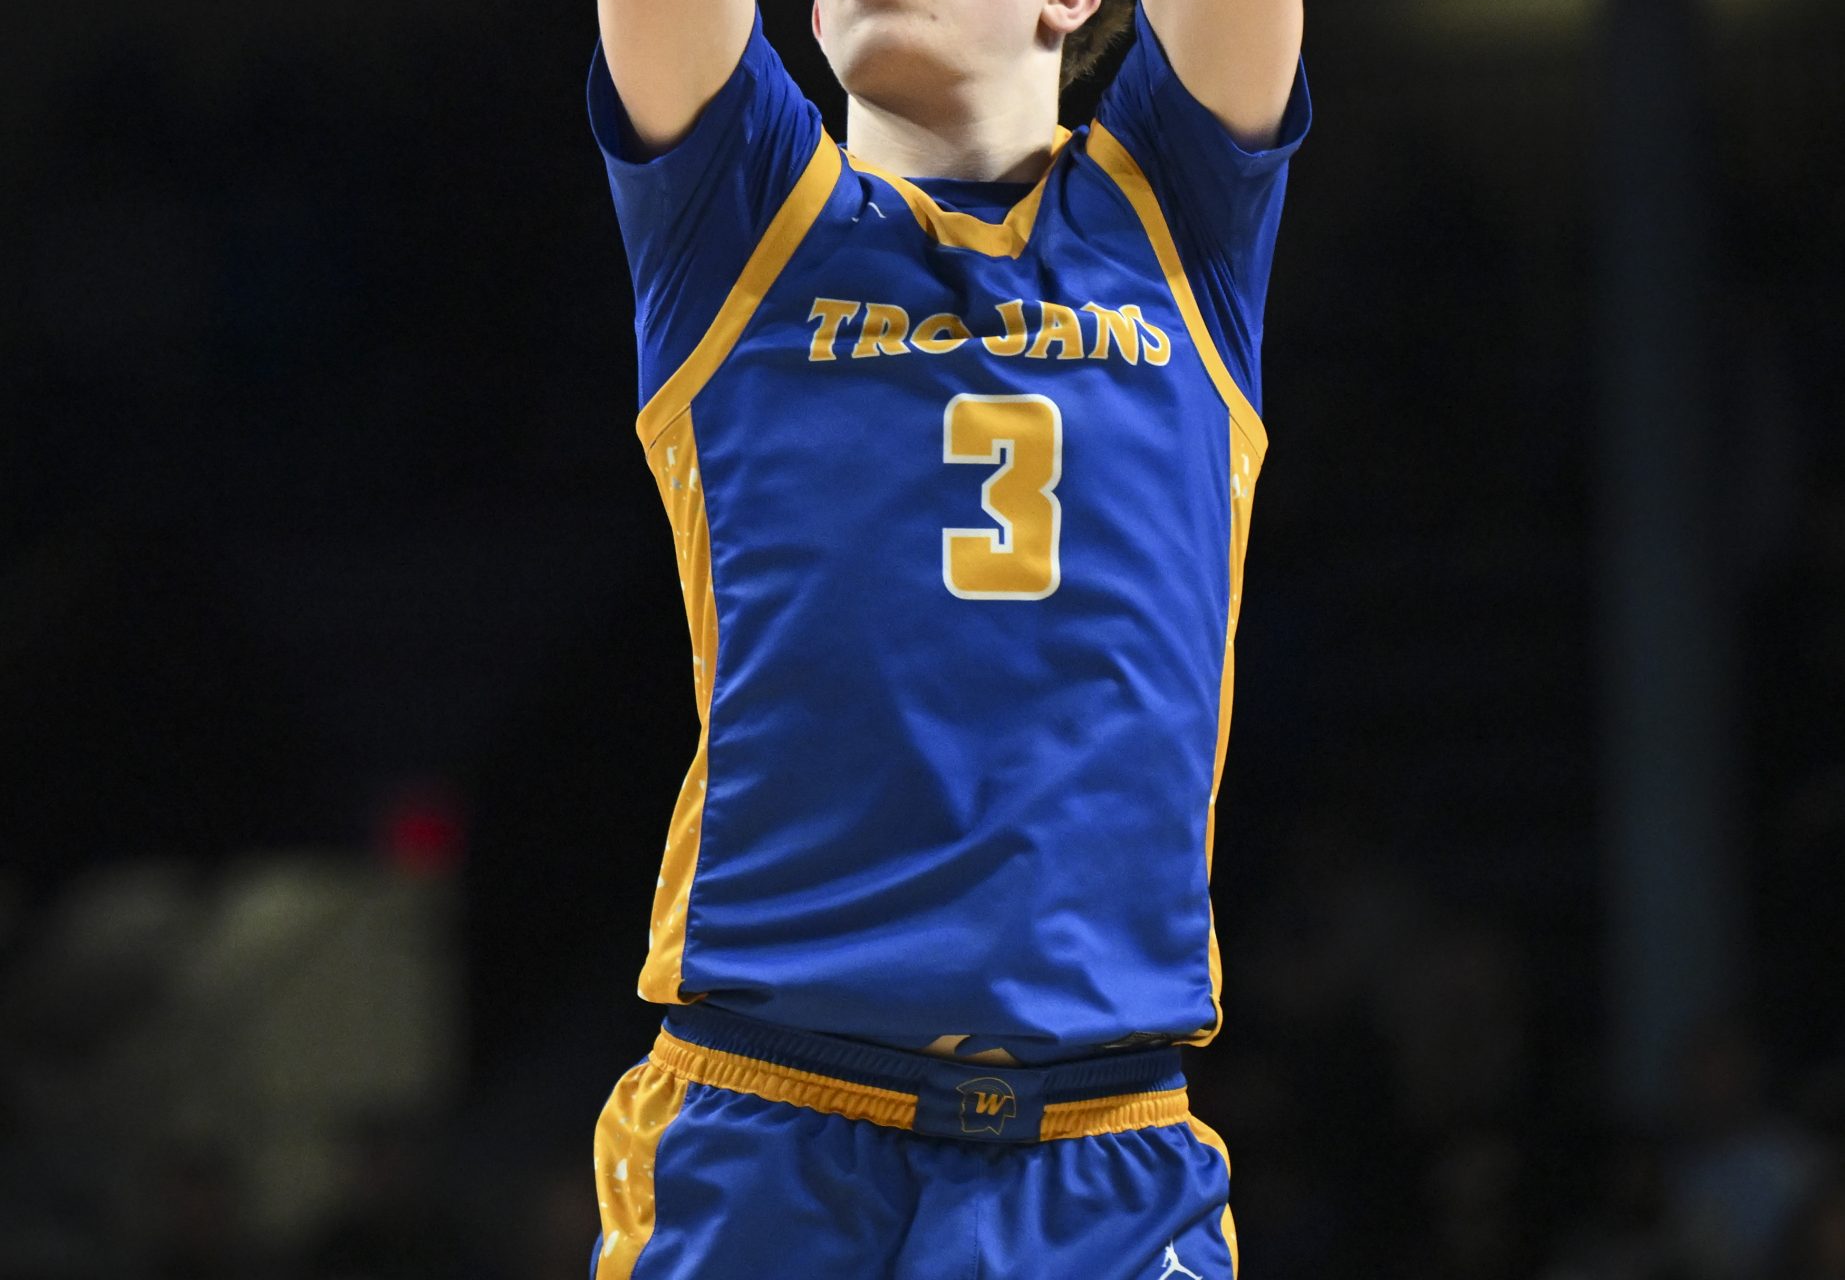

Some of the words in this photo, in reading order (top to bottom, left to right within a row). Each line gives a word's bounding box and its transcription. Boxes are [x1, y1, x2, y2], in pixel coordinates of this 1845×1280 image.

[807, 297, 1171, 367] TROJANS
[943, 393, 1063, 601] 3
[974, 1090, 1006, 1117] W
